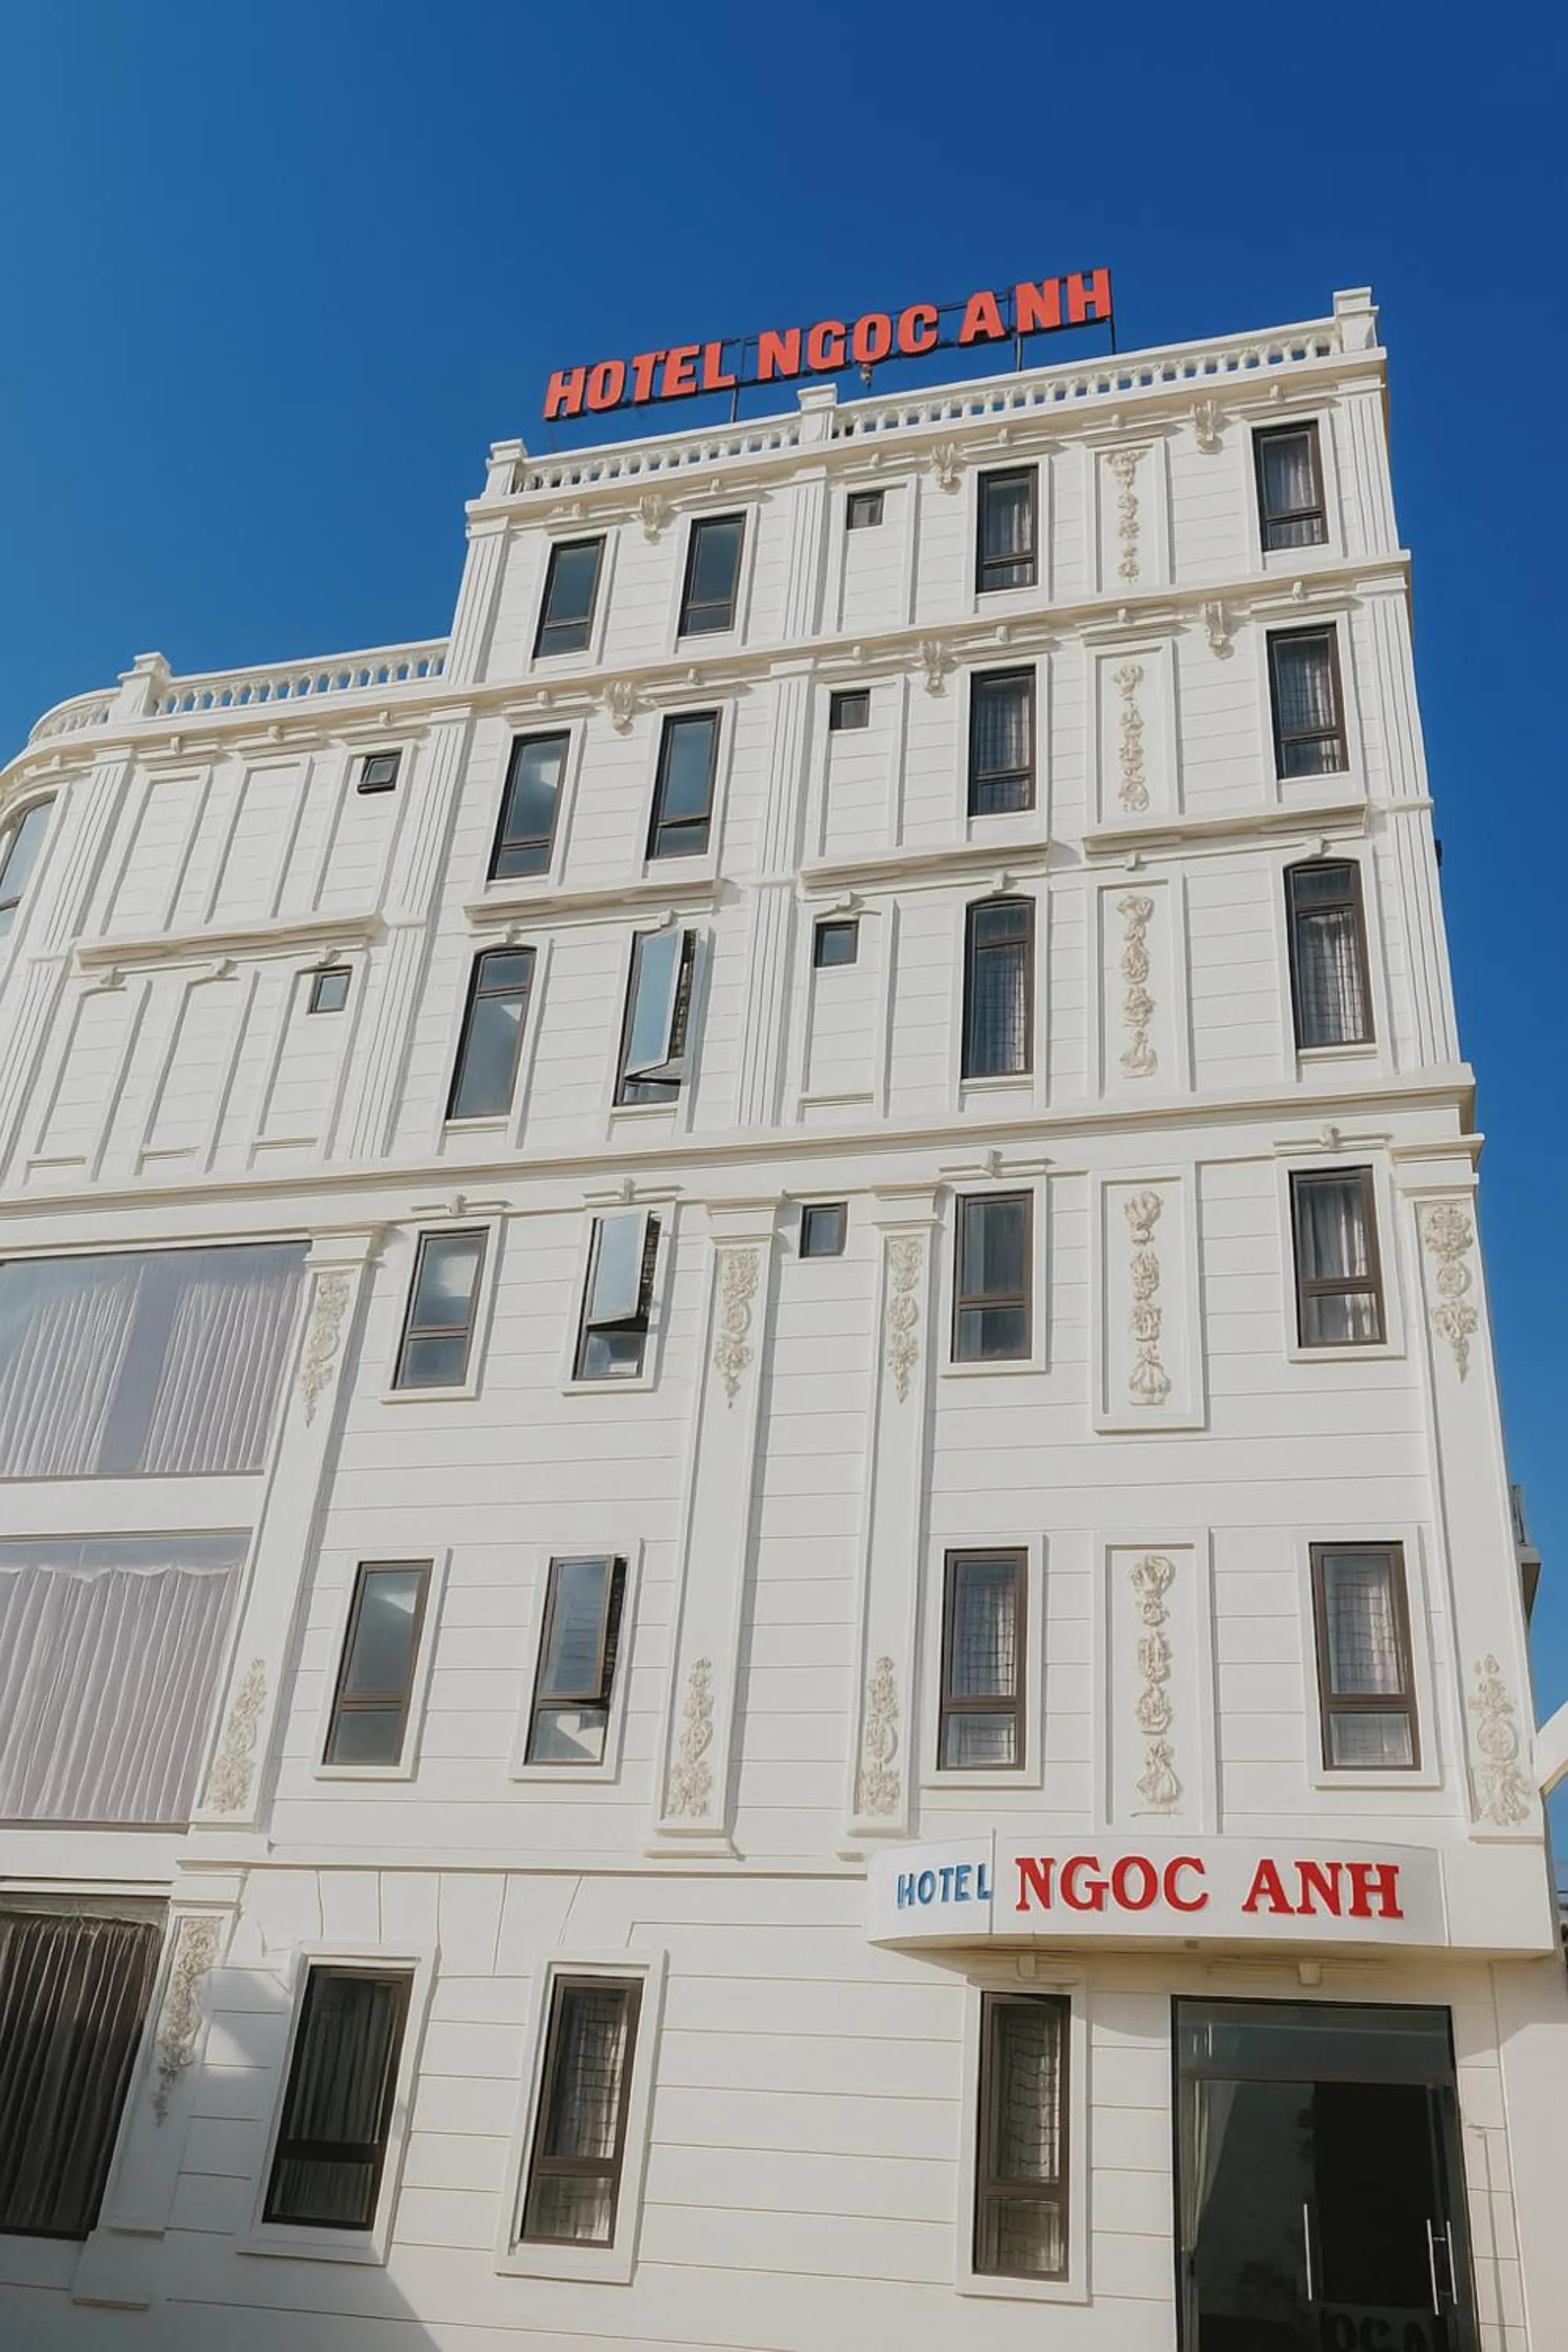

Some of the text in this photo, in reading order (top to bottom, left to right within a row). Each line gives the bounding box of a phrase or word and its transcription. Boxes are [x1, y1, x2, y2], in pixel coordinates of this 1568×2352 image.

[543, 267, 1112, 419] HOTEL NGOC ANH
[897, 1855, 1405, 1920] HOTEL NGOC ANH
